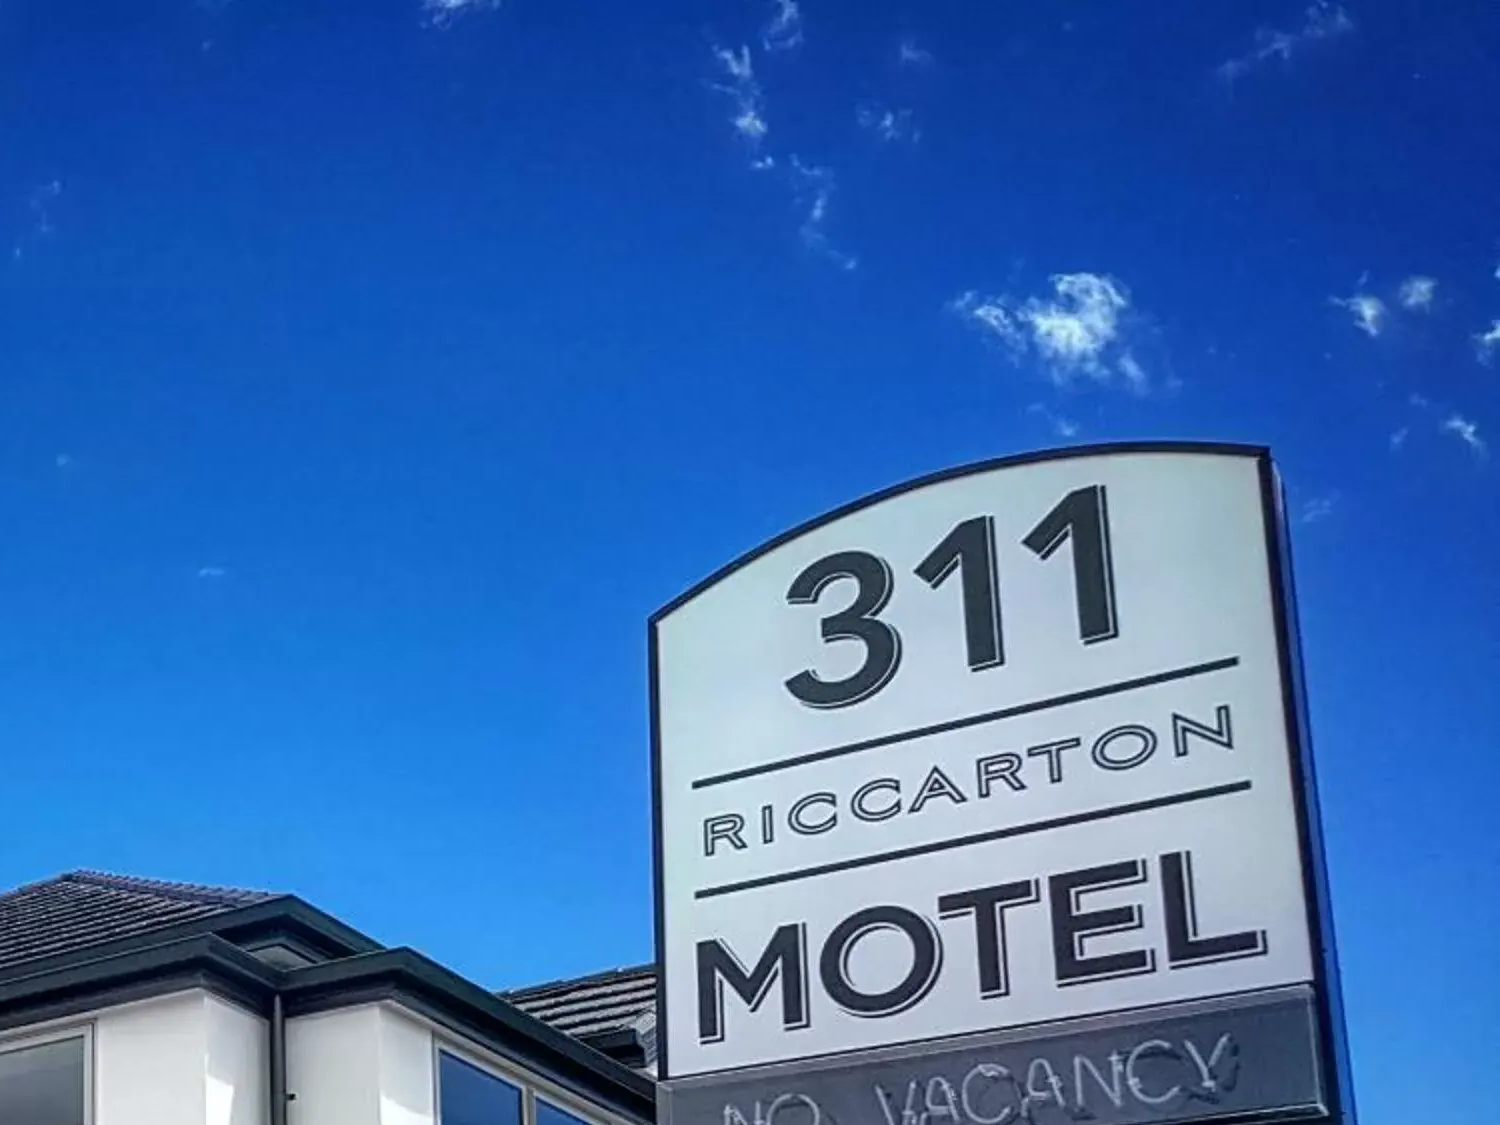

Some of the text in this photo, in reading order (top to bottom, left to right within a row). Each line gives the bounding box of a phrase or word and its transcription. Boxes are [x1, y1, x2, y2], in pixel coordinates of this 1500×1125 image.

[784, 484, 1119, 709] 311
[703, 705, 1234, 856] RICCARTON
[696, 850, 1268, 1044] MOTEL
